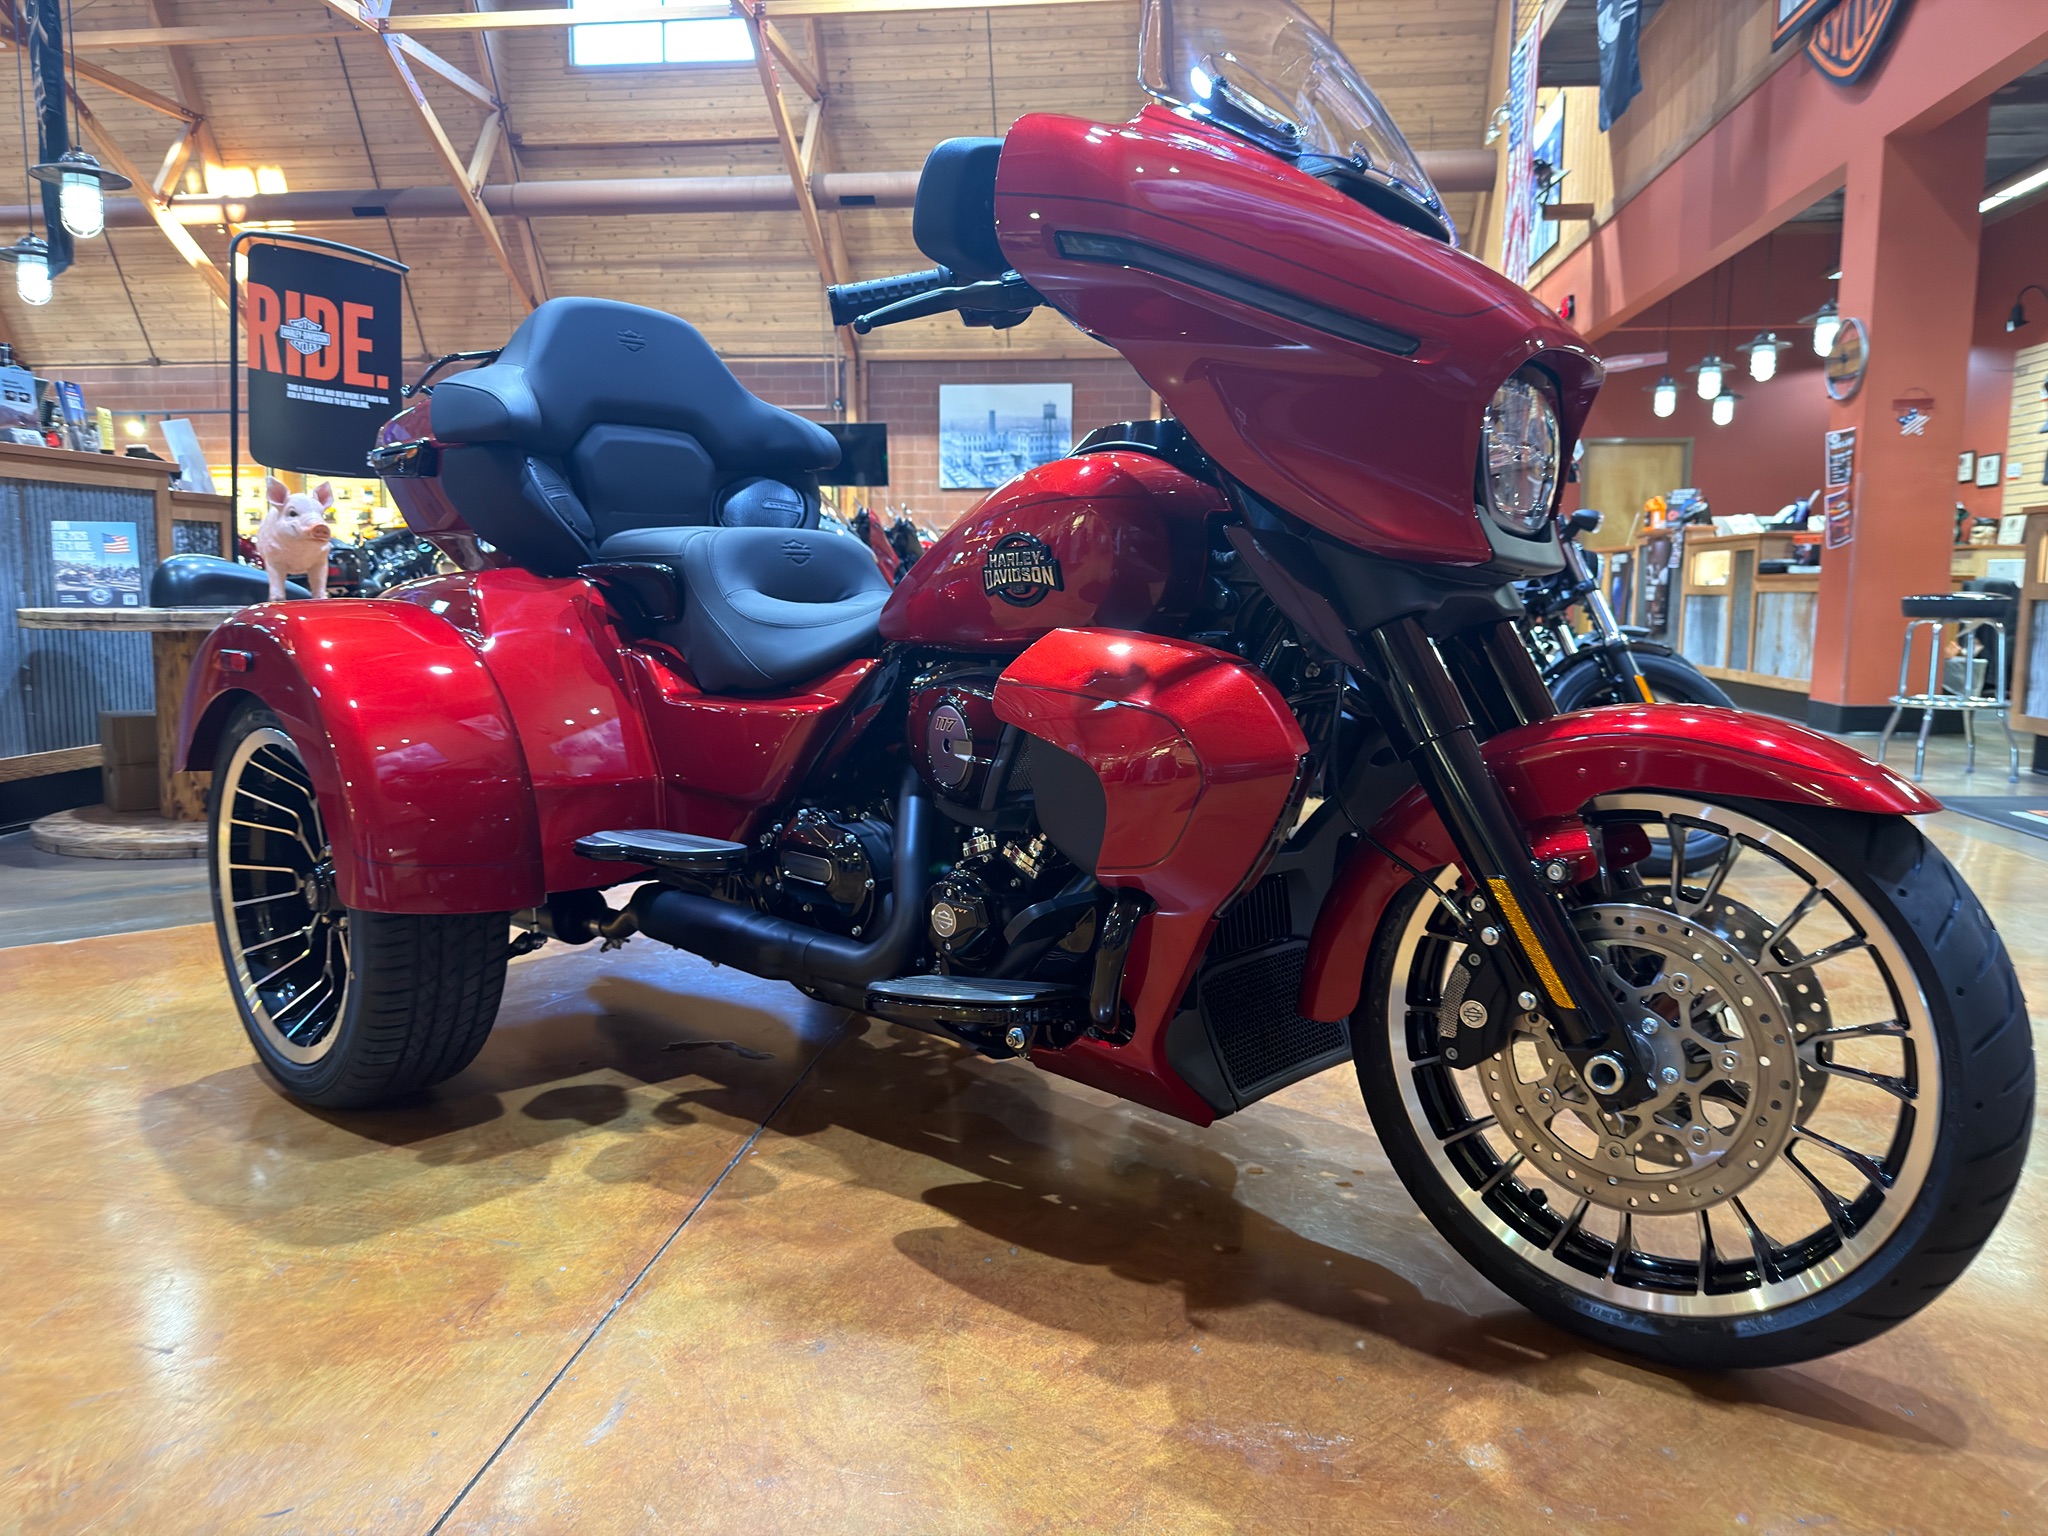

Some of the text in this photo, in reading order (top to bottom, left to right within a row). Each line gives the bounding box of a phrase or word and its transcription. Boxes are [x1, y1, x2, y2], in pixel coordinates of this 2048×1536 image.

[247, 281, 389, 390] RIDE.
[989, 550, 1045, 568] HARLEY-
[984, 565, 1055, 590] DAVIDSON
[935, 716, 959, 732] 117
